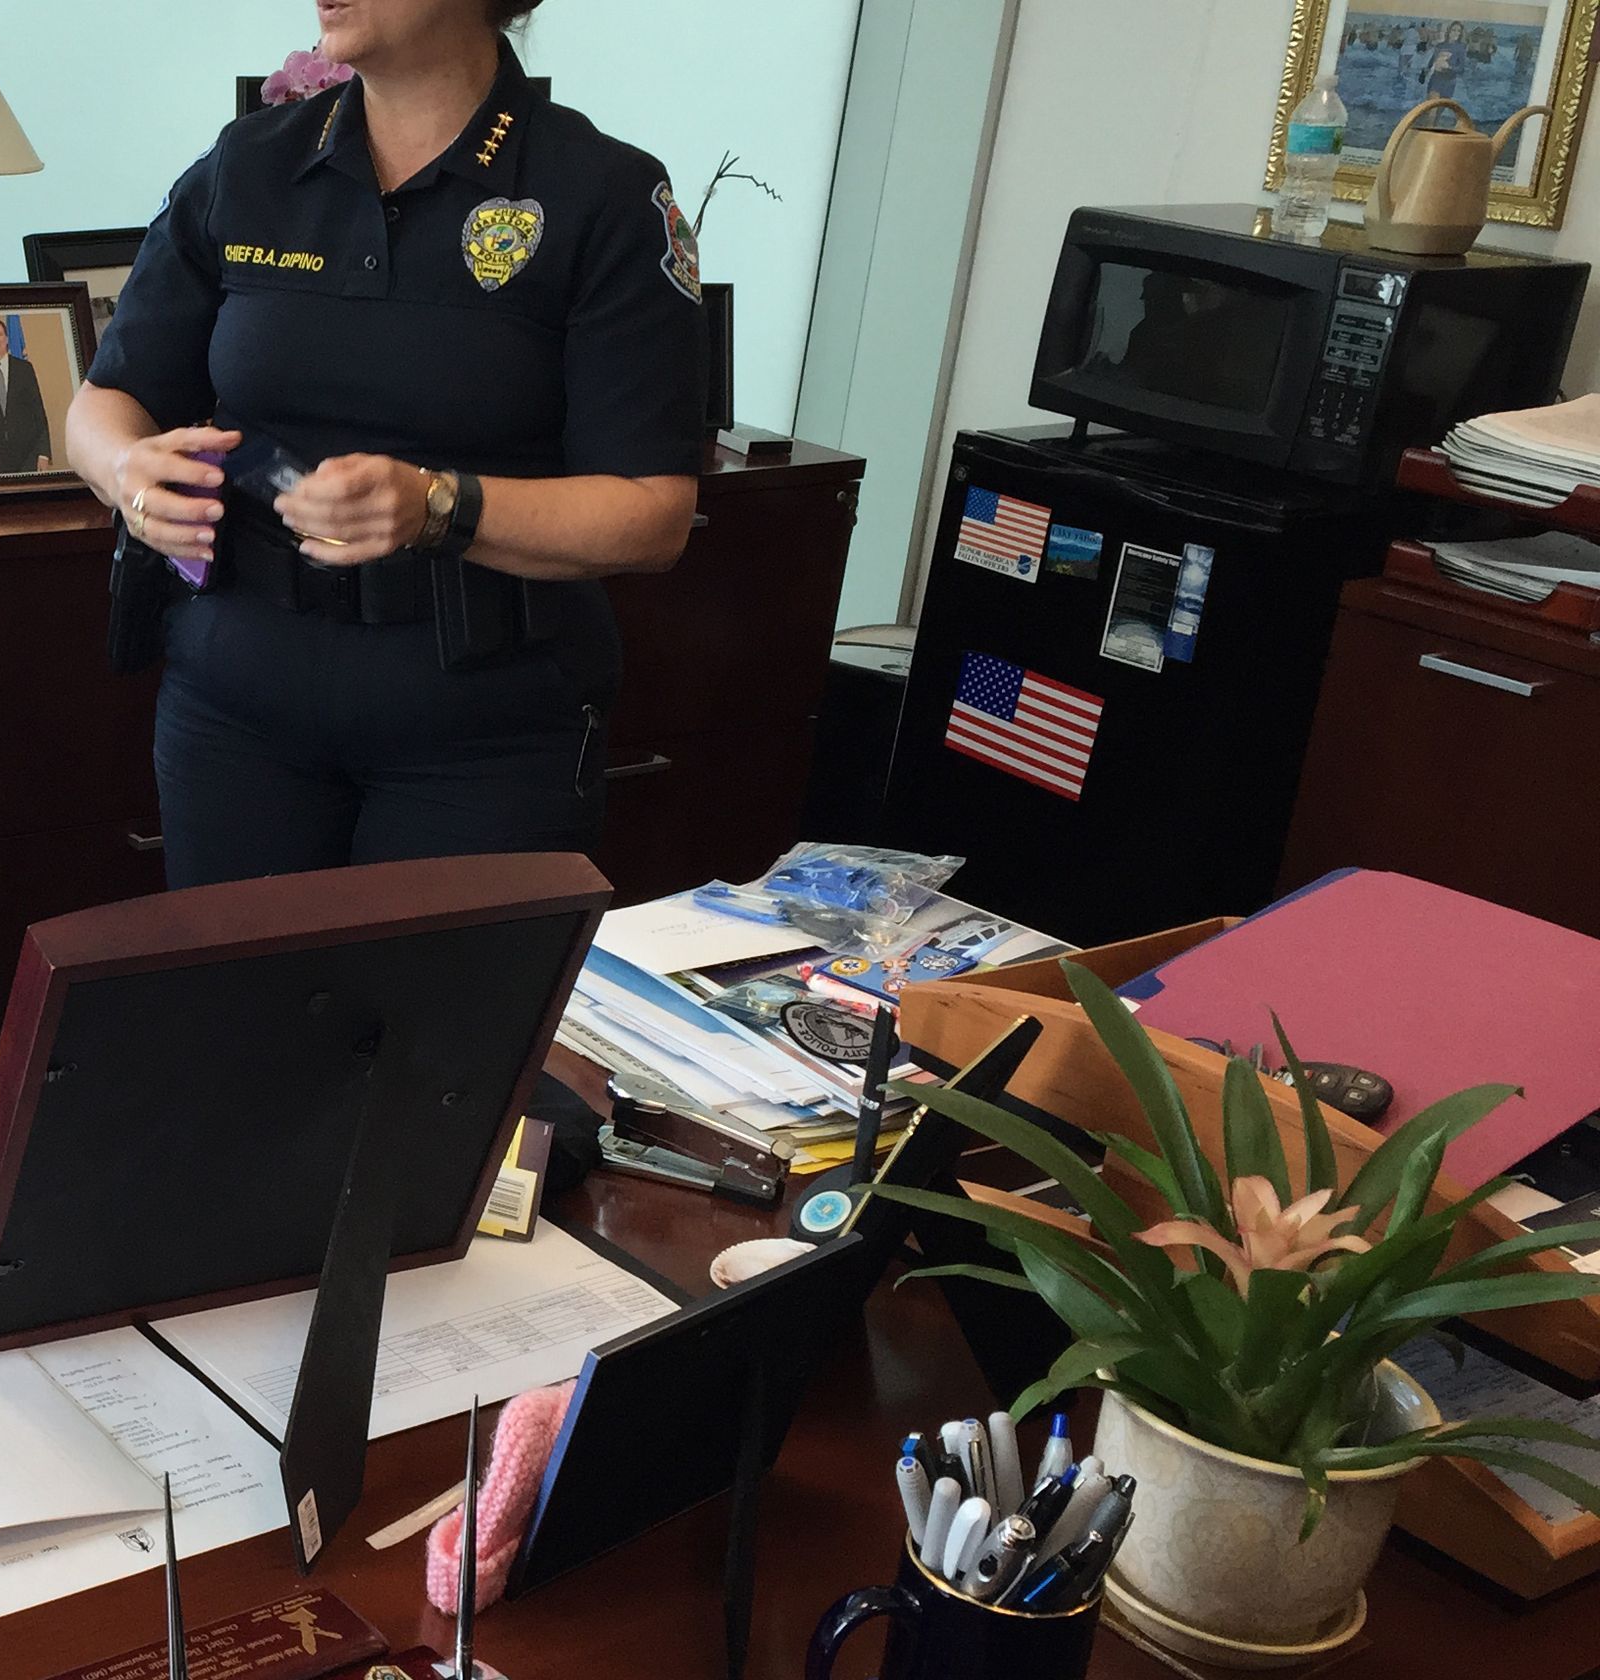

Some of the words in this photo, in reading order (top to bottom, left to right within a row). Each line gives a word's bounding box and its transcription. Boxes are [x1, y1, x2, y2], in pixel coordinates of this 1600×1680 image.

[224, 245, 254, 262] CHIEF
[252, 247, 276, 266] B.A.
[278, 252, 324, 272] DIPINO
[798, 1030, 838, 1055] POLICE
[843, 1049, 870, 1058] CITY
